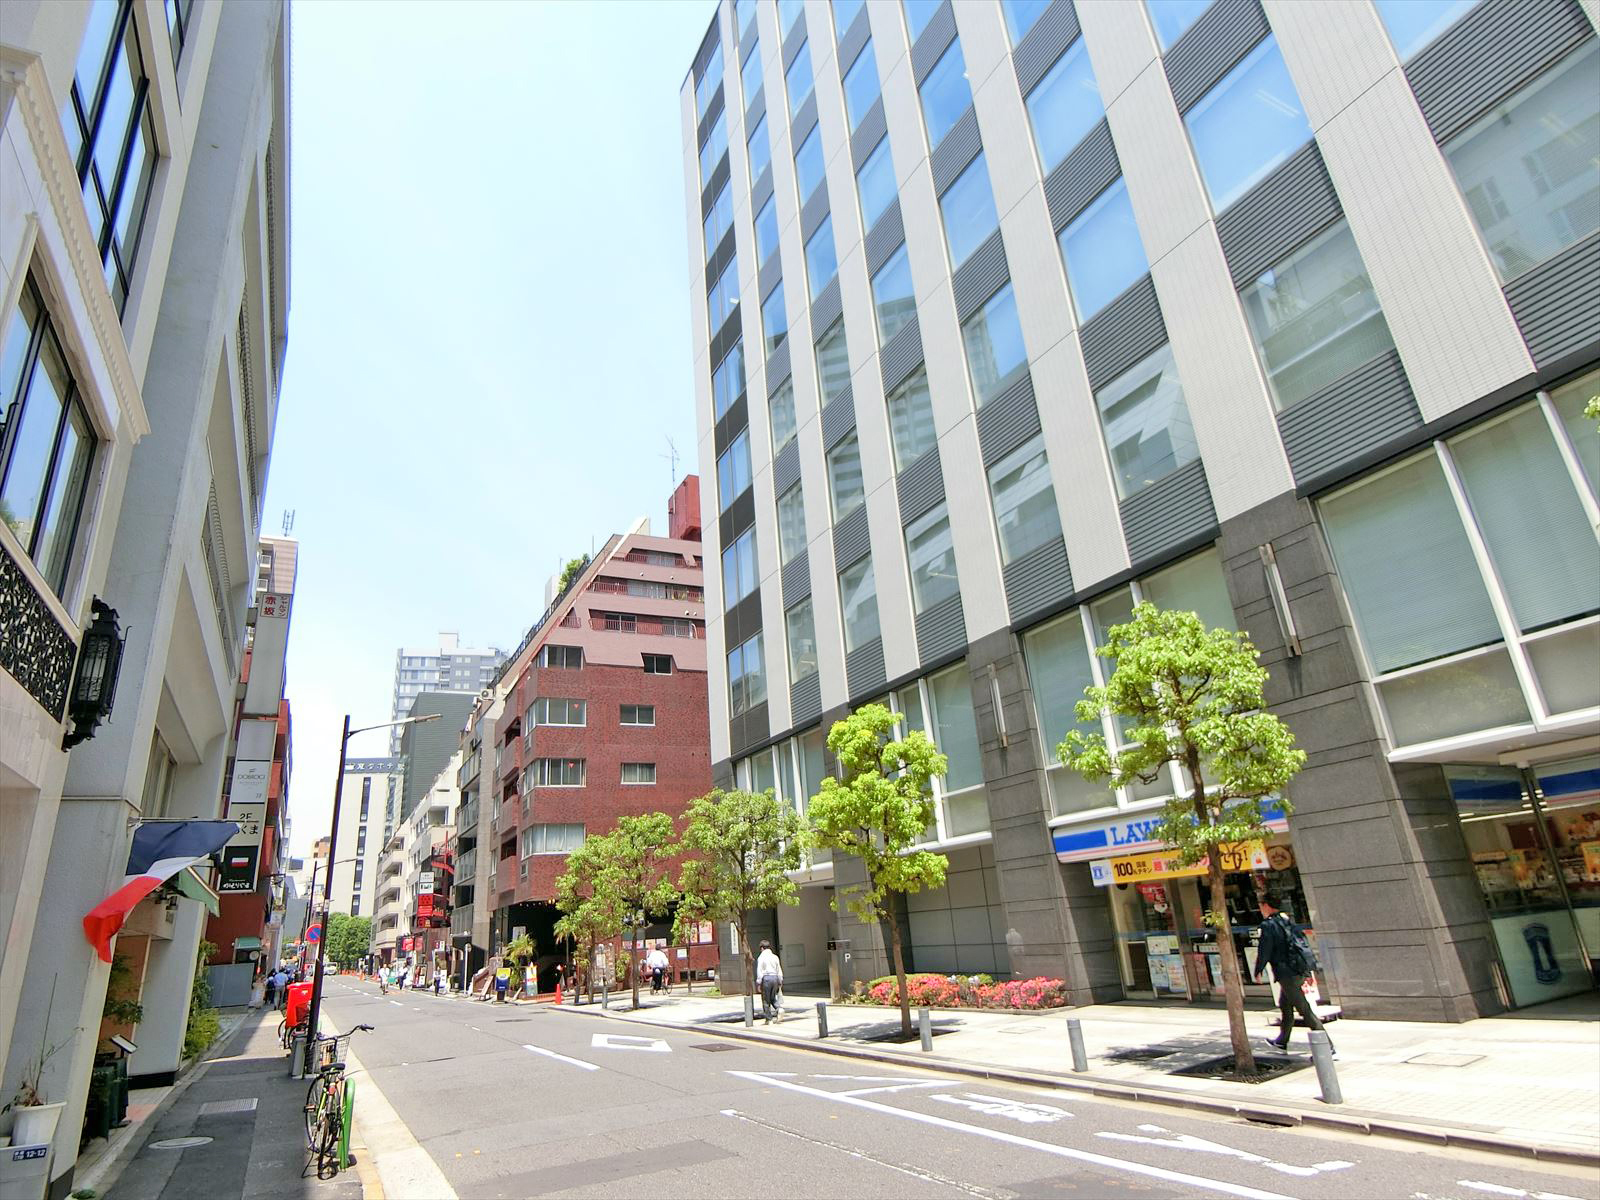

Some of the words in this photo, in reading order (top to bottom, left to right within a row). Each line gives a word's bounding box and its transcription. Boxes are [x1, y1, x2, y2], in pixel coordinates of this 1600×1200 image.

[264, 596, 276, 615] 赤坂
[235, 824, 259, 834] くま
[845, 953, 851, 963] P
